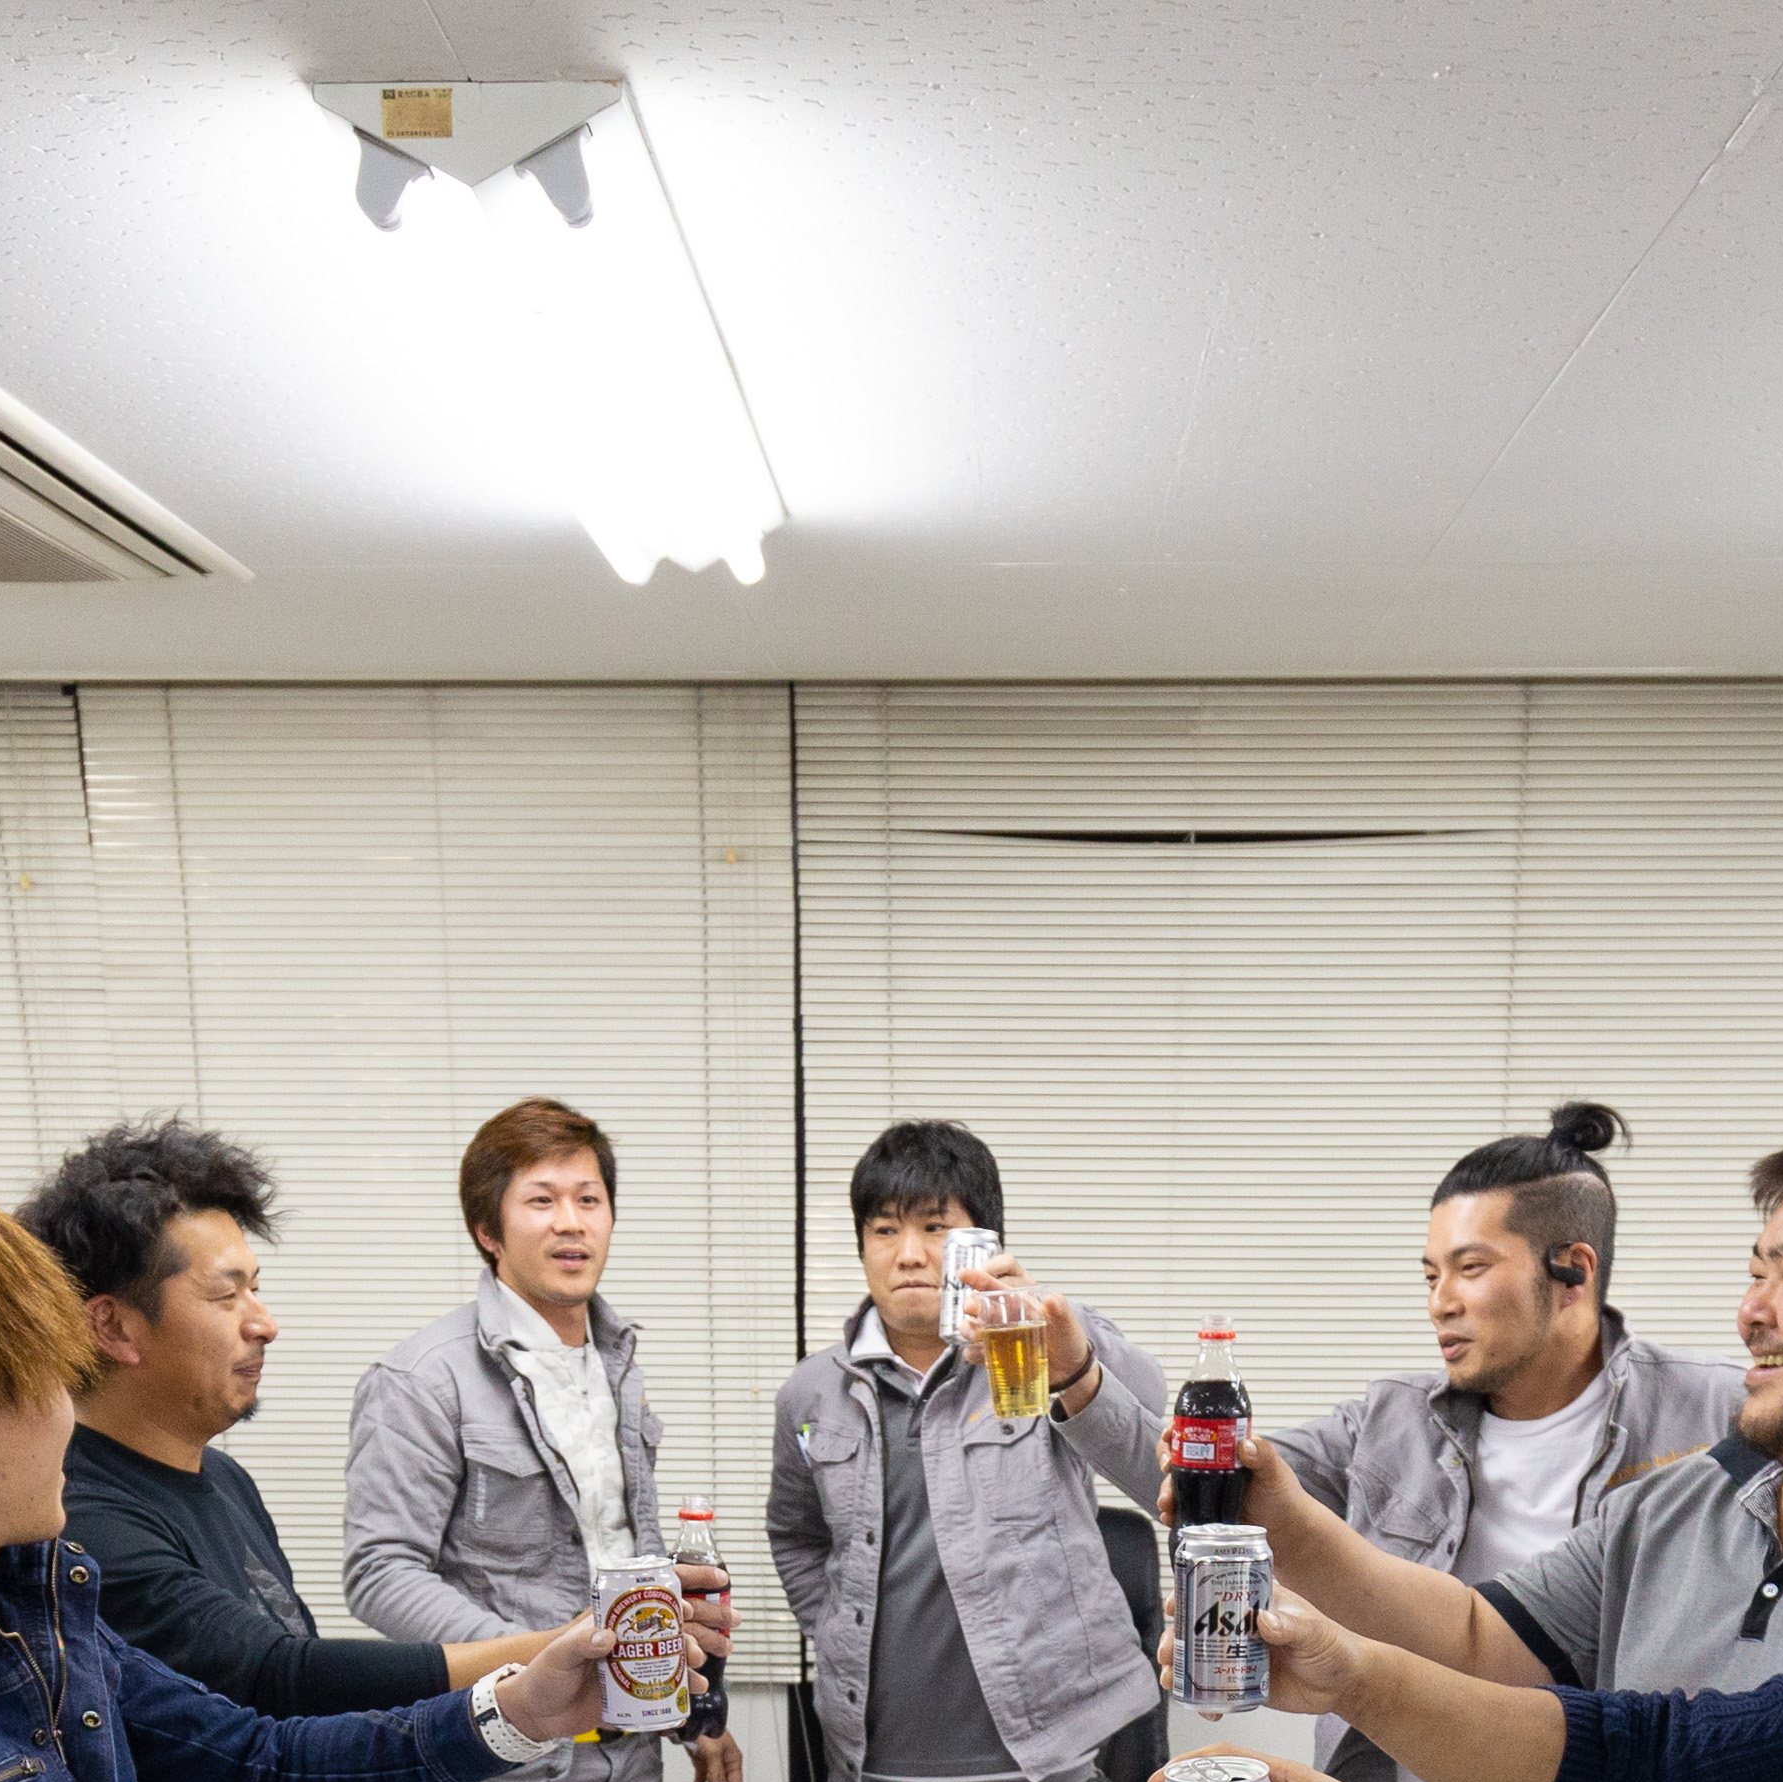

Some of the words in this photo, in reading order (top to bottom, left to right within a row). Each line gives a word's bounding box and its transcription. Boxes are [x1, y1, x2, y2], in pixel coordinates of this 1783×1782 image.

[1194, 1598, 1267, 1637] Asa
[612, 1642, 654, 1659] LAGER
[658, 1637, 683, 1656] BEER
[1226, 1643, 1248, 1659] 生
